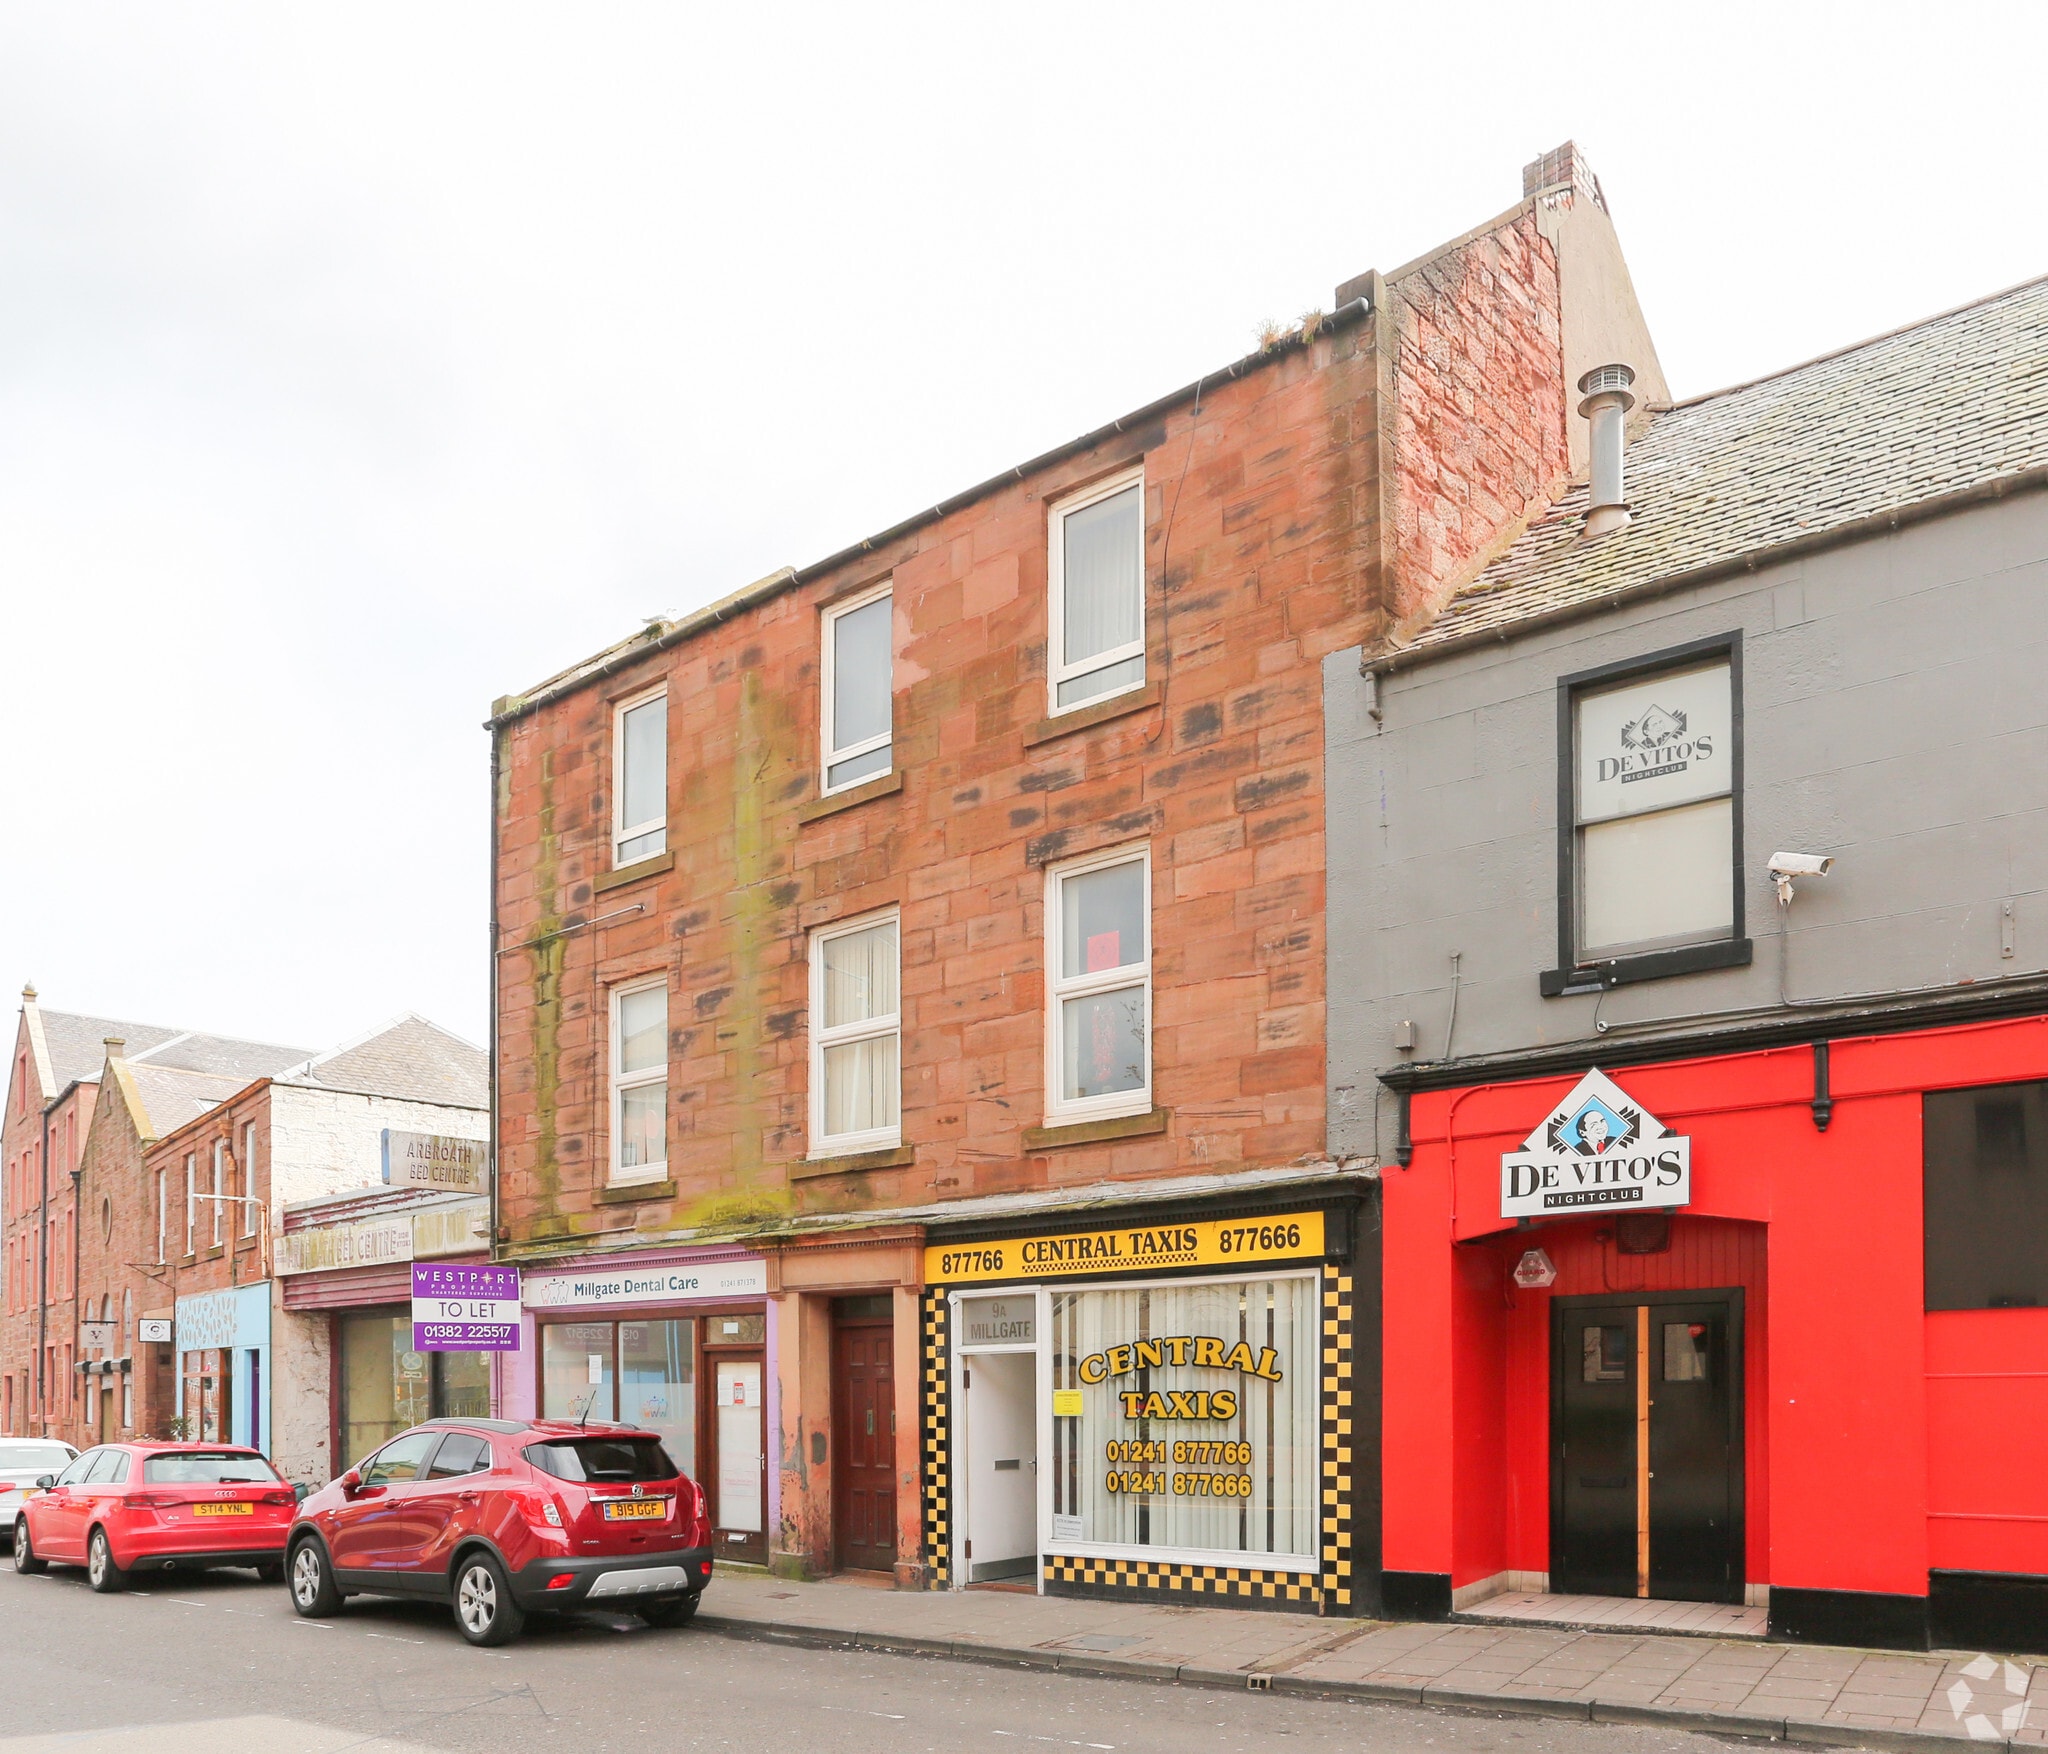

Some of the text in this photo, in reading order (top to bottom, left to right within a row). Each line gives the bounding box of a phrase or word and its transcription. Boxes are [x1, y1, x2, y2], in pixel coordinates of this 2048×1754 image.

[1597, 735, 1713, 783] DE VITO'S
[1625, 764, 1684, 782] NIGHTCLUB
[407, 1142, 471, 1164] ARBROATH
[410, 1163, 470, 1185] BED CENTRE
[1507, 1150, 1682, 1199] DE VITO'S
[1547, 1189, 1640, 1205] NIGHTCLUB
[358, 1228, 397, 1260] CENTRE
[941, 1223, 1301, 1275] 877766 CENTRAL TAXIS 877666
[574, 1275, 699, 1299] Millgate Dental Care
[438, 1302, 496, 1318] TO LET
[992, 1302, 1007, 1318] 9A
[424, 1325, 511, 1338] 01382 225517
[970, 1320, 1031, 1340] MILLGATE
[1079, 1336, 1283, 1385] CENTRAL
[1119, 1390, 1237, 1421] TAXIS
[1106, 1440, 1252, 1465] 01241 877766
[1106, 1470, 1252, 1497] 01241 877666
[200, 1504, 246, 1514] ST14 YNL
[637, 1503, 657, 1515] GGF
